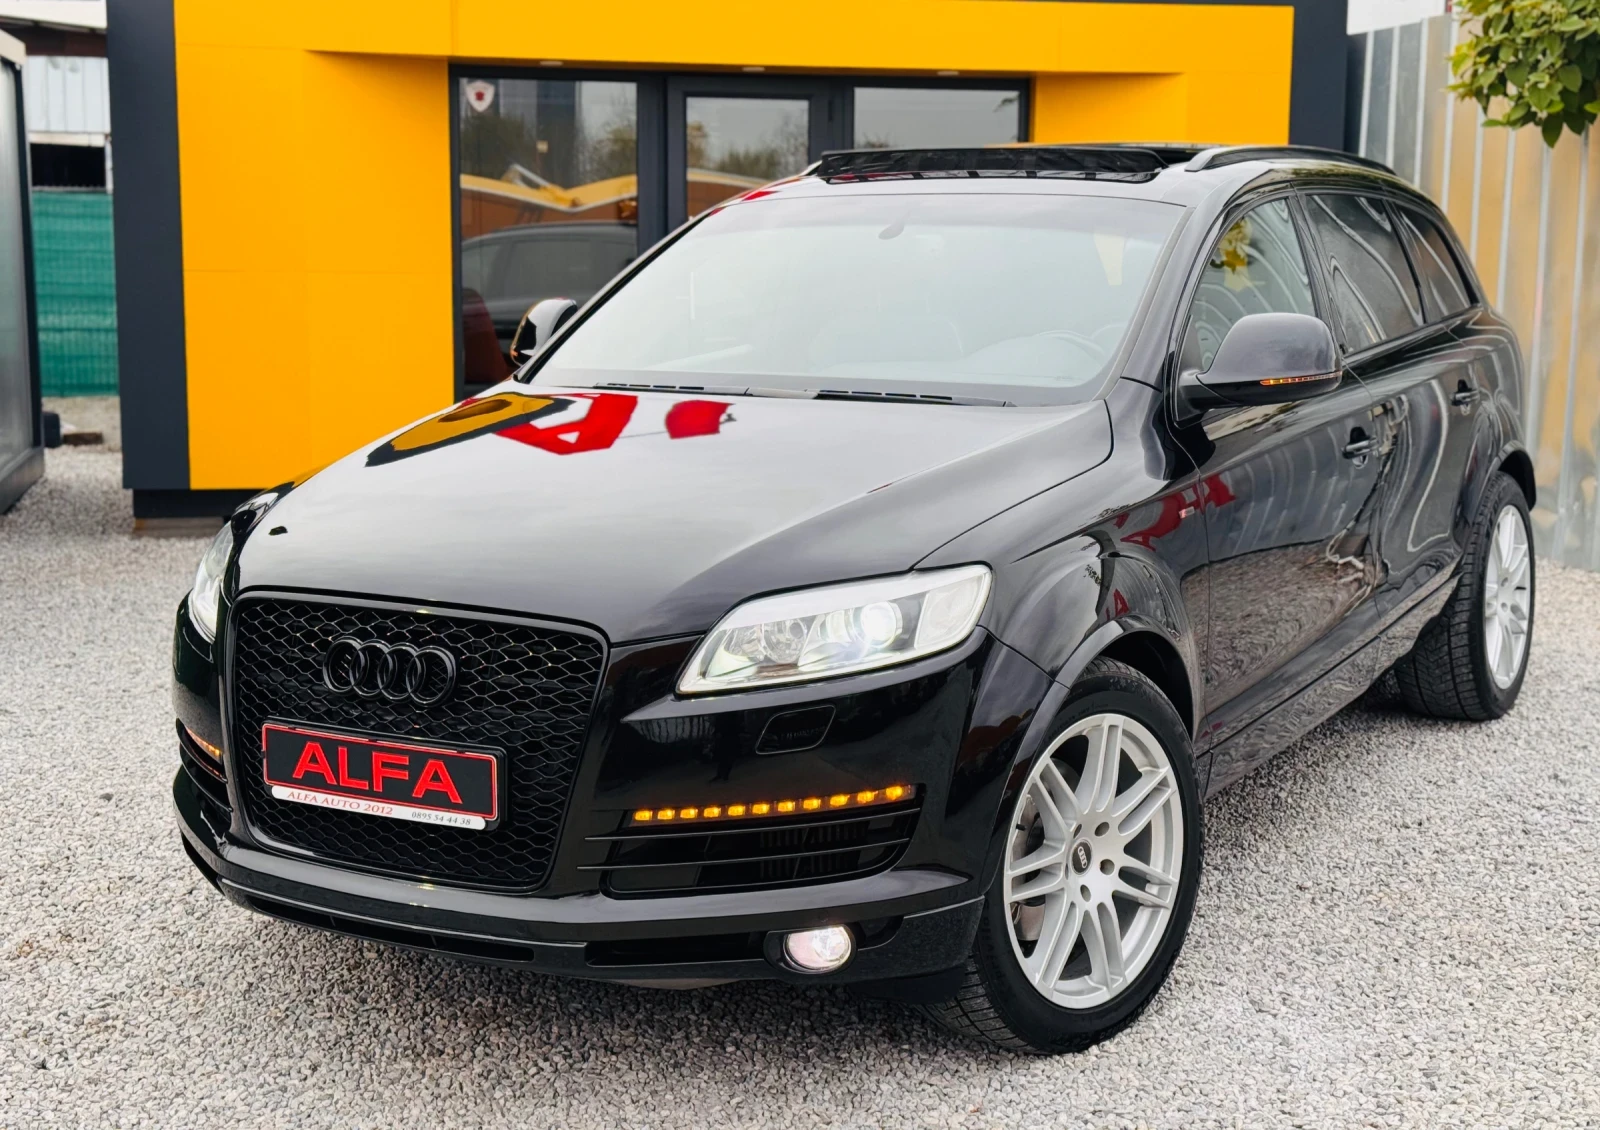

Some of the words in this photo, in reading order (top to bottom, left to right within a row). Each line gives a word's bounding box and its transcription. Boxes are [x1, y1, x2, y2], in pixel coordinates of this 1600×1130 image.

[292, 741, 463, 804] ALFA
[287, 791, 318, 804] ALFA
[321, 798, 360, 810] AUTO
[364, 803, 393, 815] 2012
[411, 811, 432, 820] 0895
[433, 814, 444, 822] 54
[446, 816, 458, 824] 44
[460, 817, 471, 825] 38
